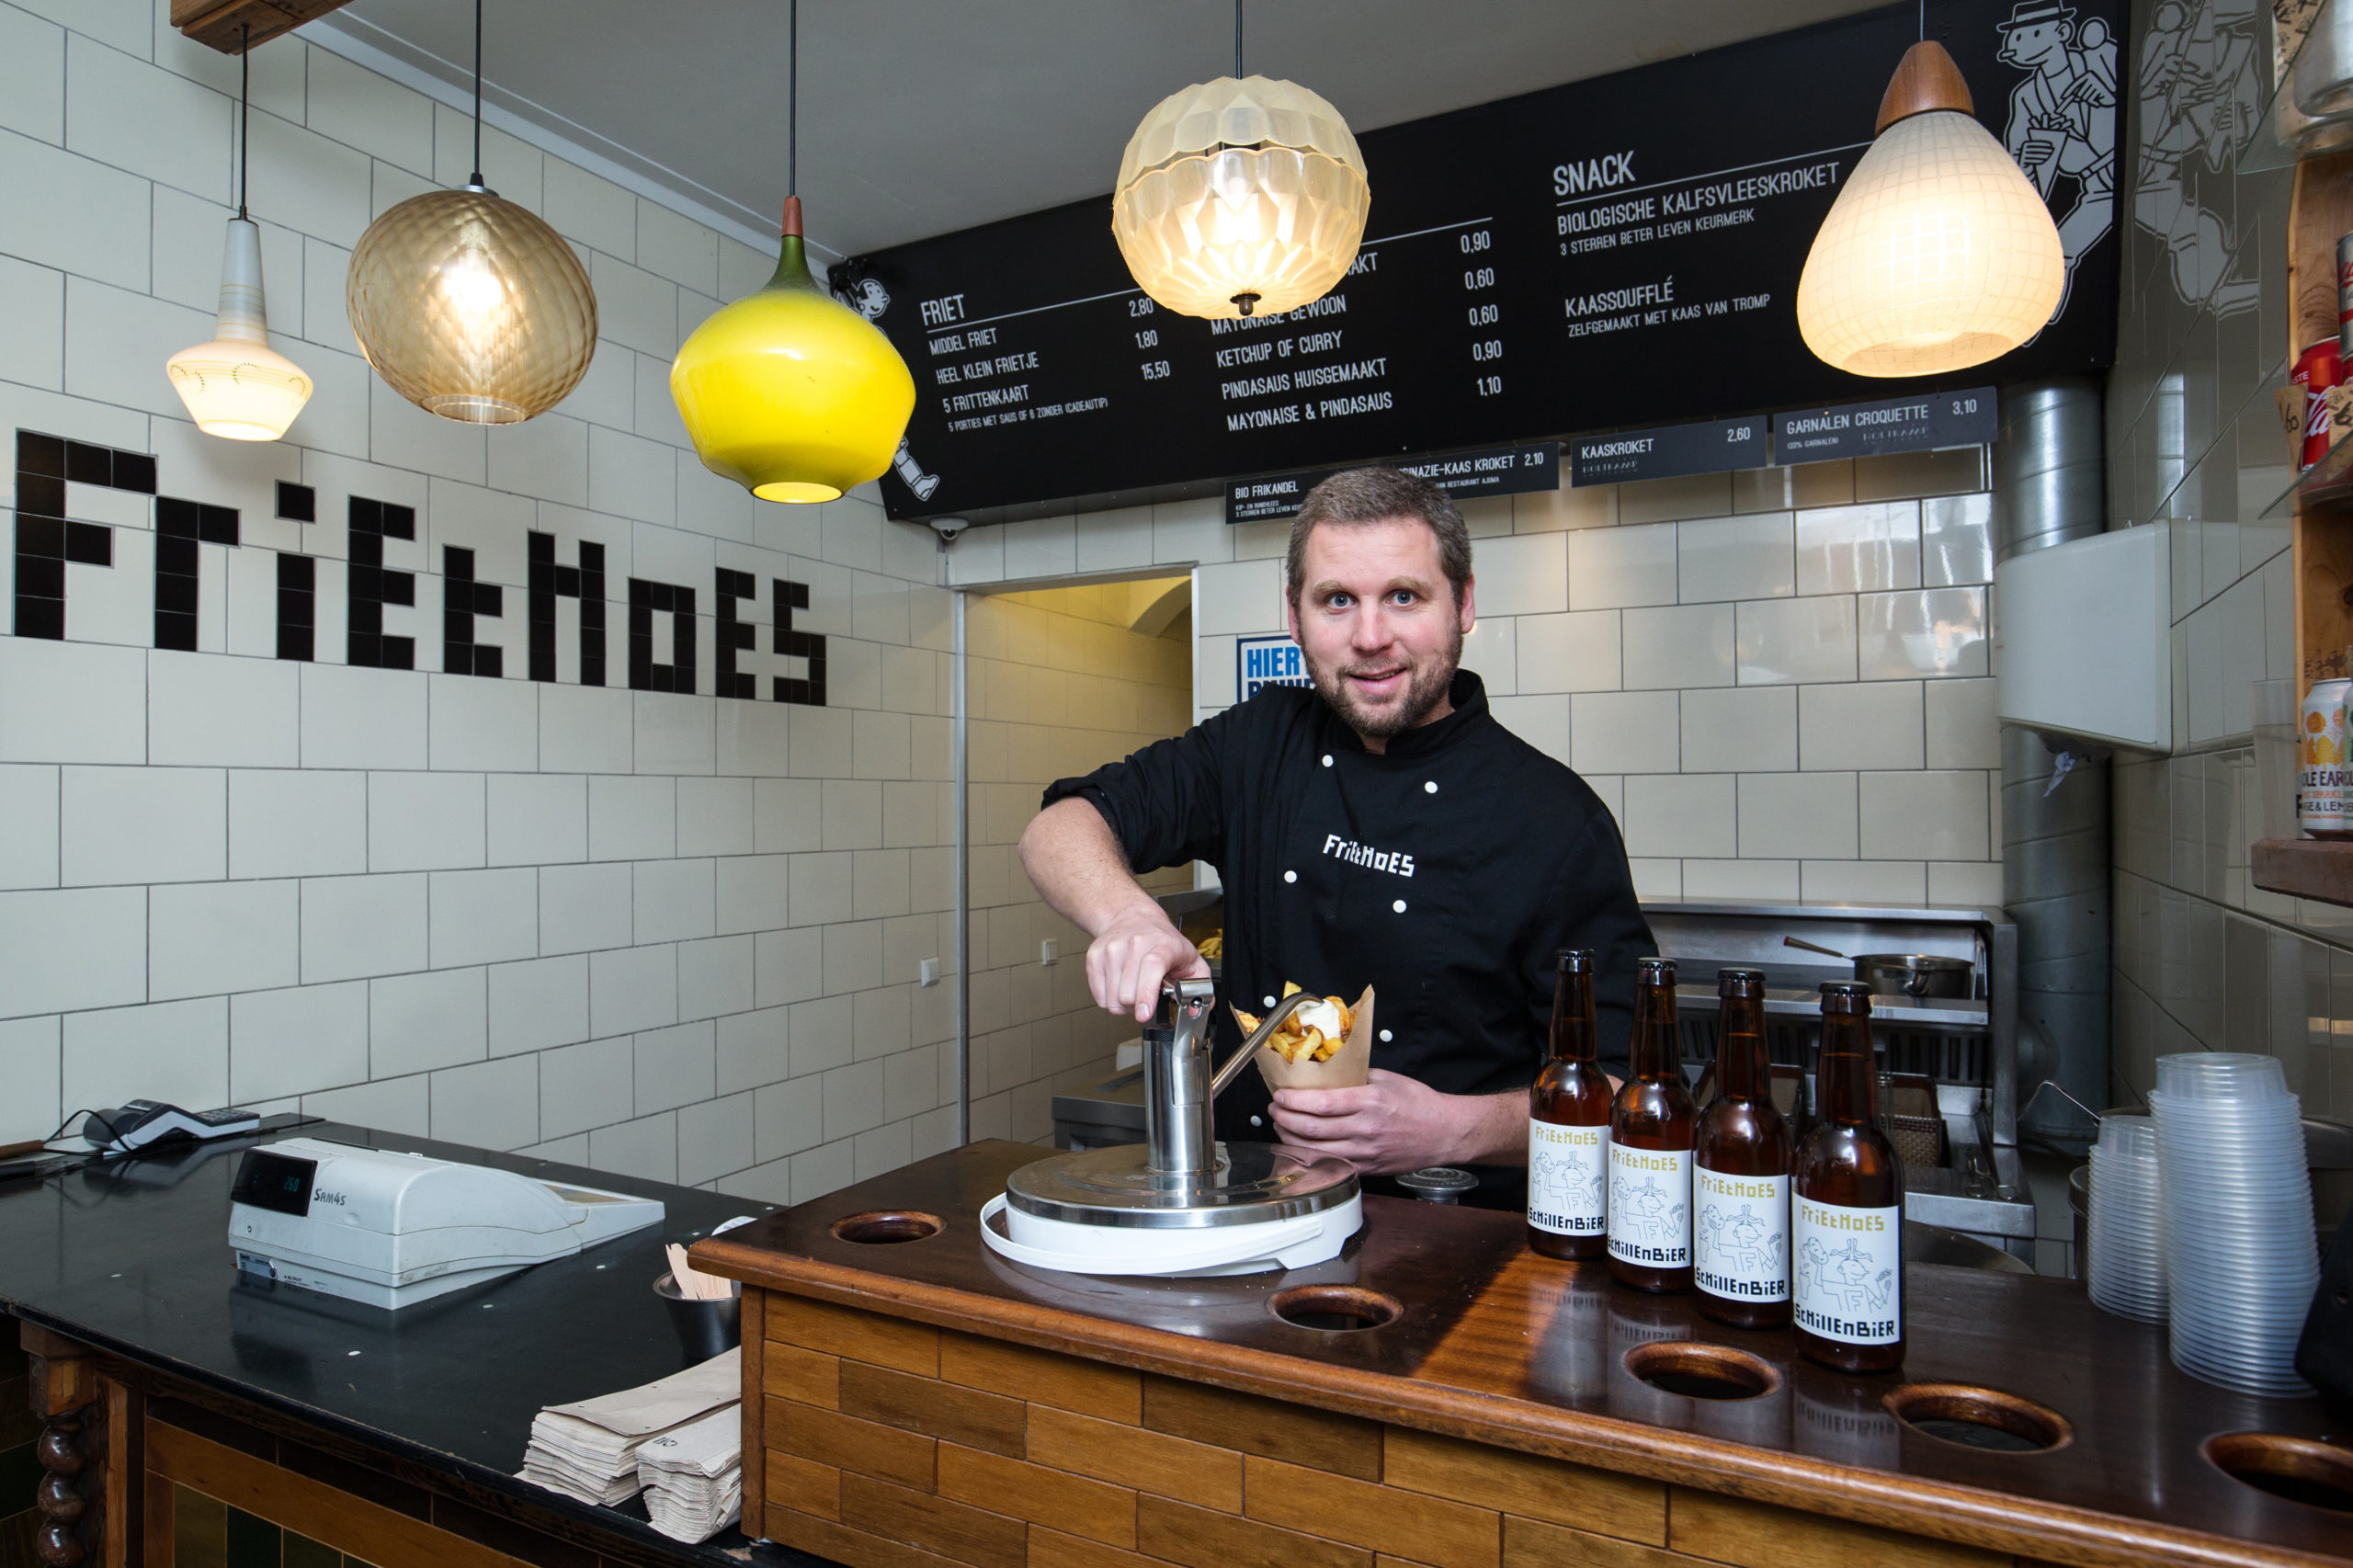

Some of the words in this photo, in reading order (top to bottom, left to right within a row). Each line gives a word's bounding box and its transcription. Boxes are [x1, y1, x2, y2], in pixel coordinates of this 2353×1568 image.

[1553, 151, 1636, 197] SNACK
[1557, 198, 1655, 235] BIOLOGISCHE
[1662, 162, 1840, 216] KALFSVLEESKROKET
[1560, 244, 1568, 256] 3
[1571, 233, 1617, 255] STERREN
[1620, 227, 1654, 245] BETER
[1657, 220, 1692, 239] LEVEN
[1695, 208, 1756, 232] KEURMERK
[920, 294, 966, 325] FRIET
[1290, 294, 1347, 321] GEWOON
[1565, 275, 1674, 318] KAASSOUFFLÉ
[1568, 313, 1641, 337] ZELFGEMAAKT
[1644, 310, 1667, 326] MET
[1671, 304, 1700, 321] KAAS
[1705, 300, 1728, 315] VAN
[1732, 293, 1771, 312] TROMP
[929, 335, 966, 356] MIDDEL
[967, 328, 997, 348] FRIET
[1216, 342, 1273, 368] KETCHUP
[1278, 338, 1294, 358] OF
[1299, 330, 1343, 354] CURRY
[936, 366, 961, 384] HEEL
[963, 359, 994, 380] KLEIN
[995, 352, 1040, 374] FRIETJE
[1222, 374, 1290, 400] PINDASAUS
[1294, 358, 1387, 389] HUISGEMAAKT
[942, 398, 951, 413] 5
[953, 385, 1029, 412] FRITTENKAART
[1227, 404, 1300, 432] MAYONAISE
[1305, 403, 1316, 419] &
[1320, 392, 1393, 418] PINDASAUS
[955, 417, 982, 431] PORTIES
[983, 415, 997, 426] MET
[1000, 412, 1017, 424] SAUS
[1019, 410, 1028, 420] OF
[1037, 404, 1063, 418] ZONDER
[1787, 415, 1849, 435] GARNALEN
[1855, 404, 1928, 426] CROQUETTE
[1475, 455, 1515, 472] KROKET
[1582, 438, 1654, 459] KAASKROKET
[1235, 487, 1249, 499] BIO
[1252, 481, 1299, 497] FRIKANDEL
[1448, 478, 1480, 488] RESTAURANT
[1247, 646, 1300, 678] HIER
